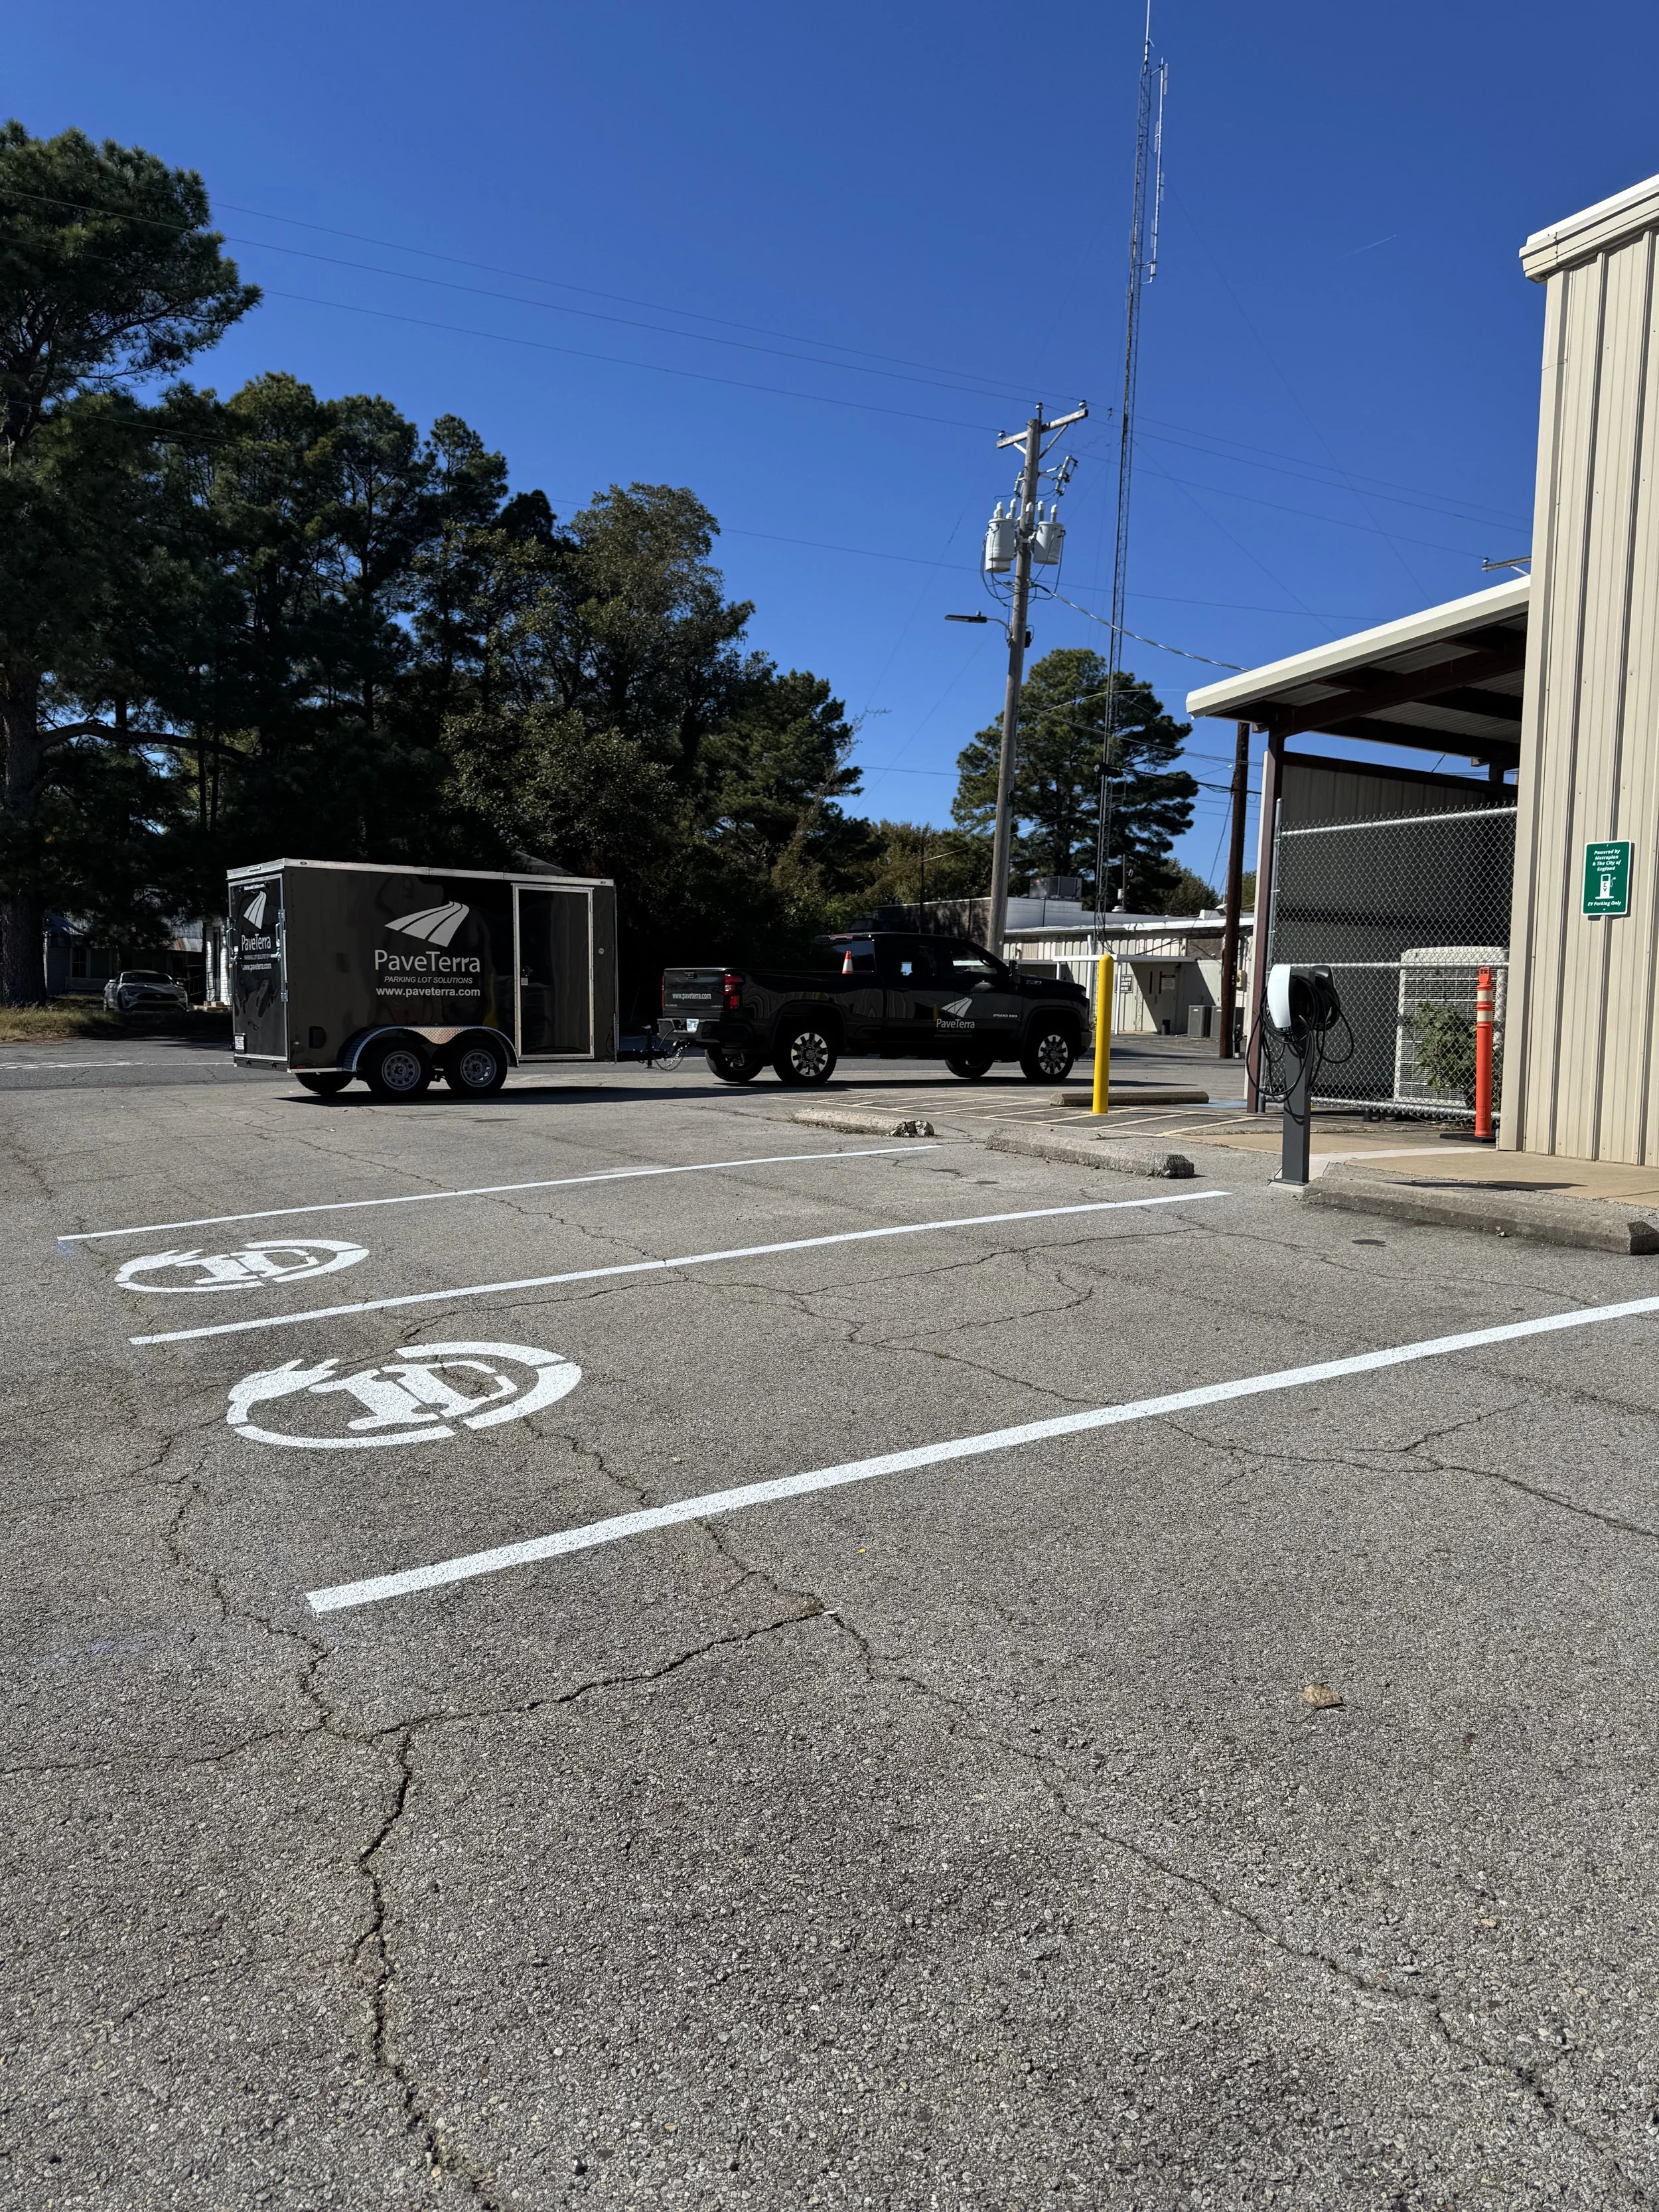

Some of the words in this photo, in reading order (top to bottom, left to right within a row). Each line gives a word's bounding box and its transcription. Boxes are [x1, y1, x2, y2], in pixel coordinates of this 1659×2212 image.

[242, 933, 271, 951] PaveTerra
[374, 950, 480, 972] PaveTerra
[376, 987, 480, 997] www.paveterra.com
[672, 992, 712, 1001] www.paveterra.com
[936, 1018, 975, 1029] PaveTerra
